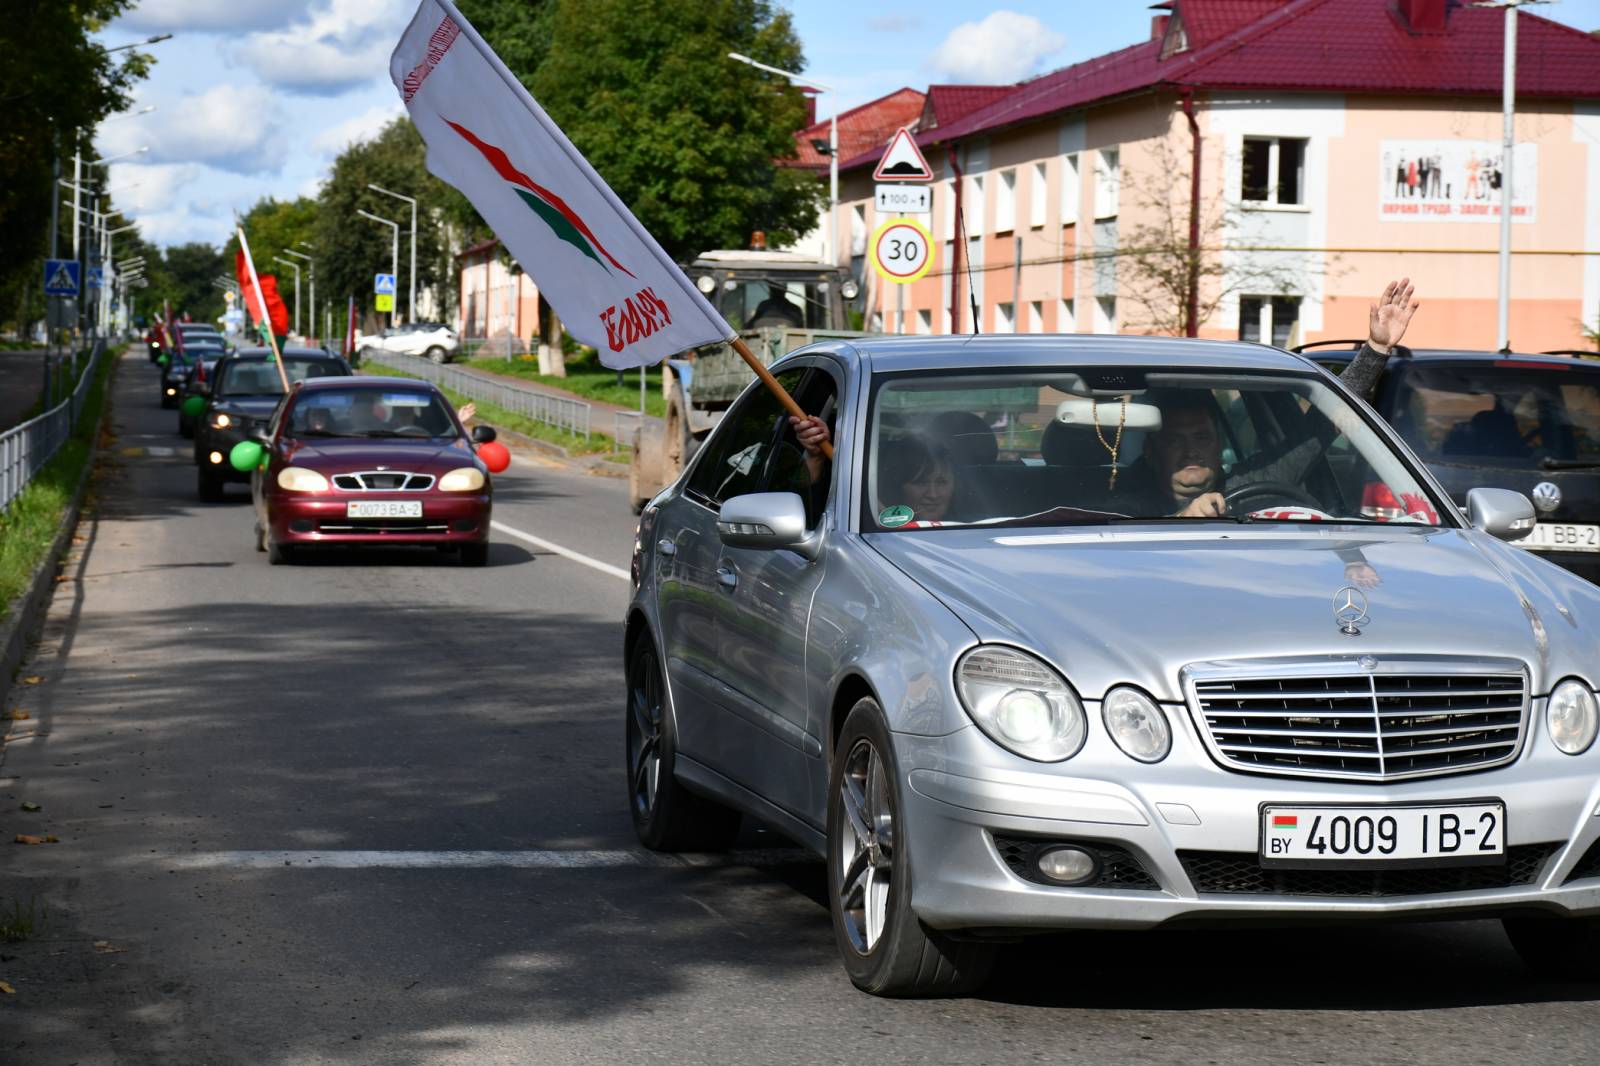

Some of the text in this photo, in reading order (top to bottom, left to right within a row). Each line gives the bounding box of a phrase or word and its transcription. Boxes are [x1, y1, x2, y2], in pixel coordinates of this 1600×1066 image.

[890, 194, 908, 204] 100
[1422, 203, 1452, 215] ТРУДА
[888, 240, 918, 261] 30
[360, 503, 387, 516] 0073
[389, 503, 420, 516] BA-2
[1554, 526, 1596, 545] BB-2
[1306, 812, 1497, 855] 4009 IB-2
[1271, 838, 1292, 854] BY
